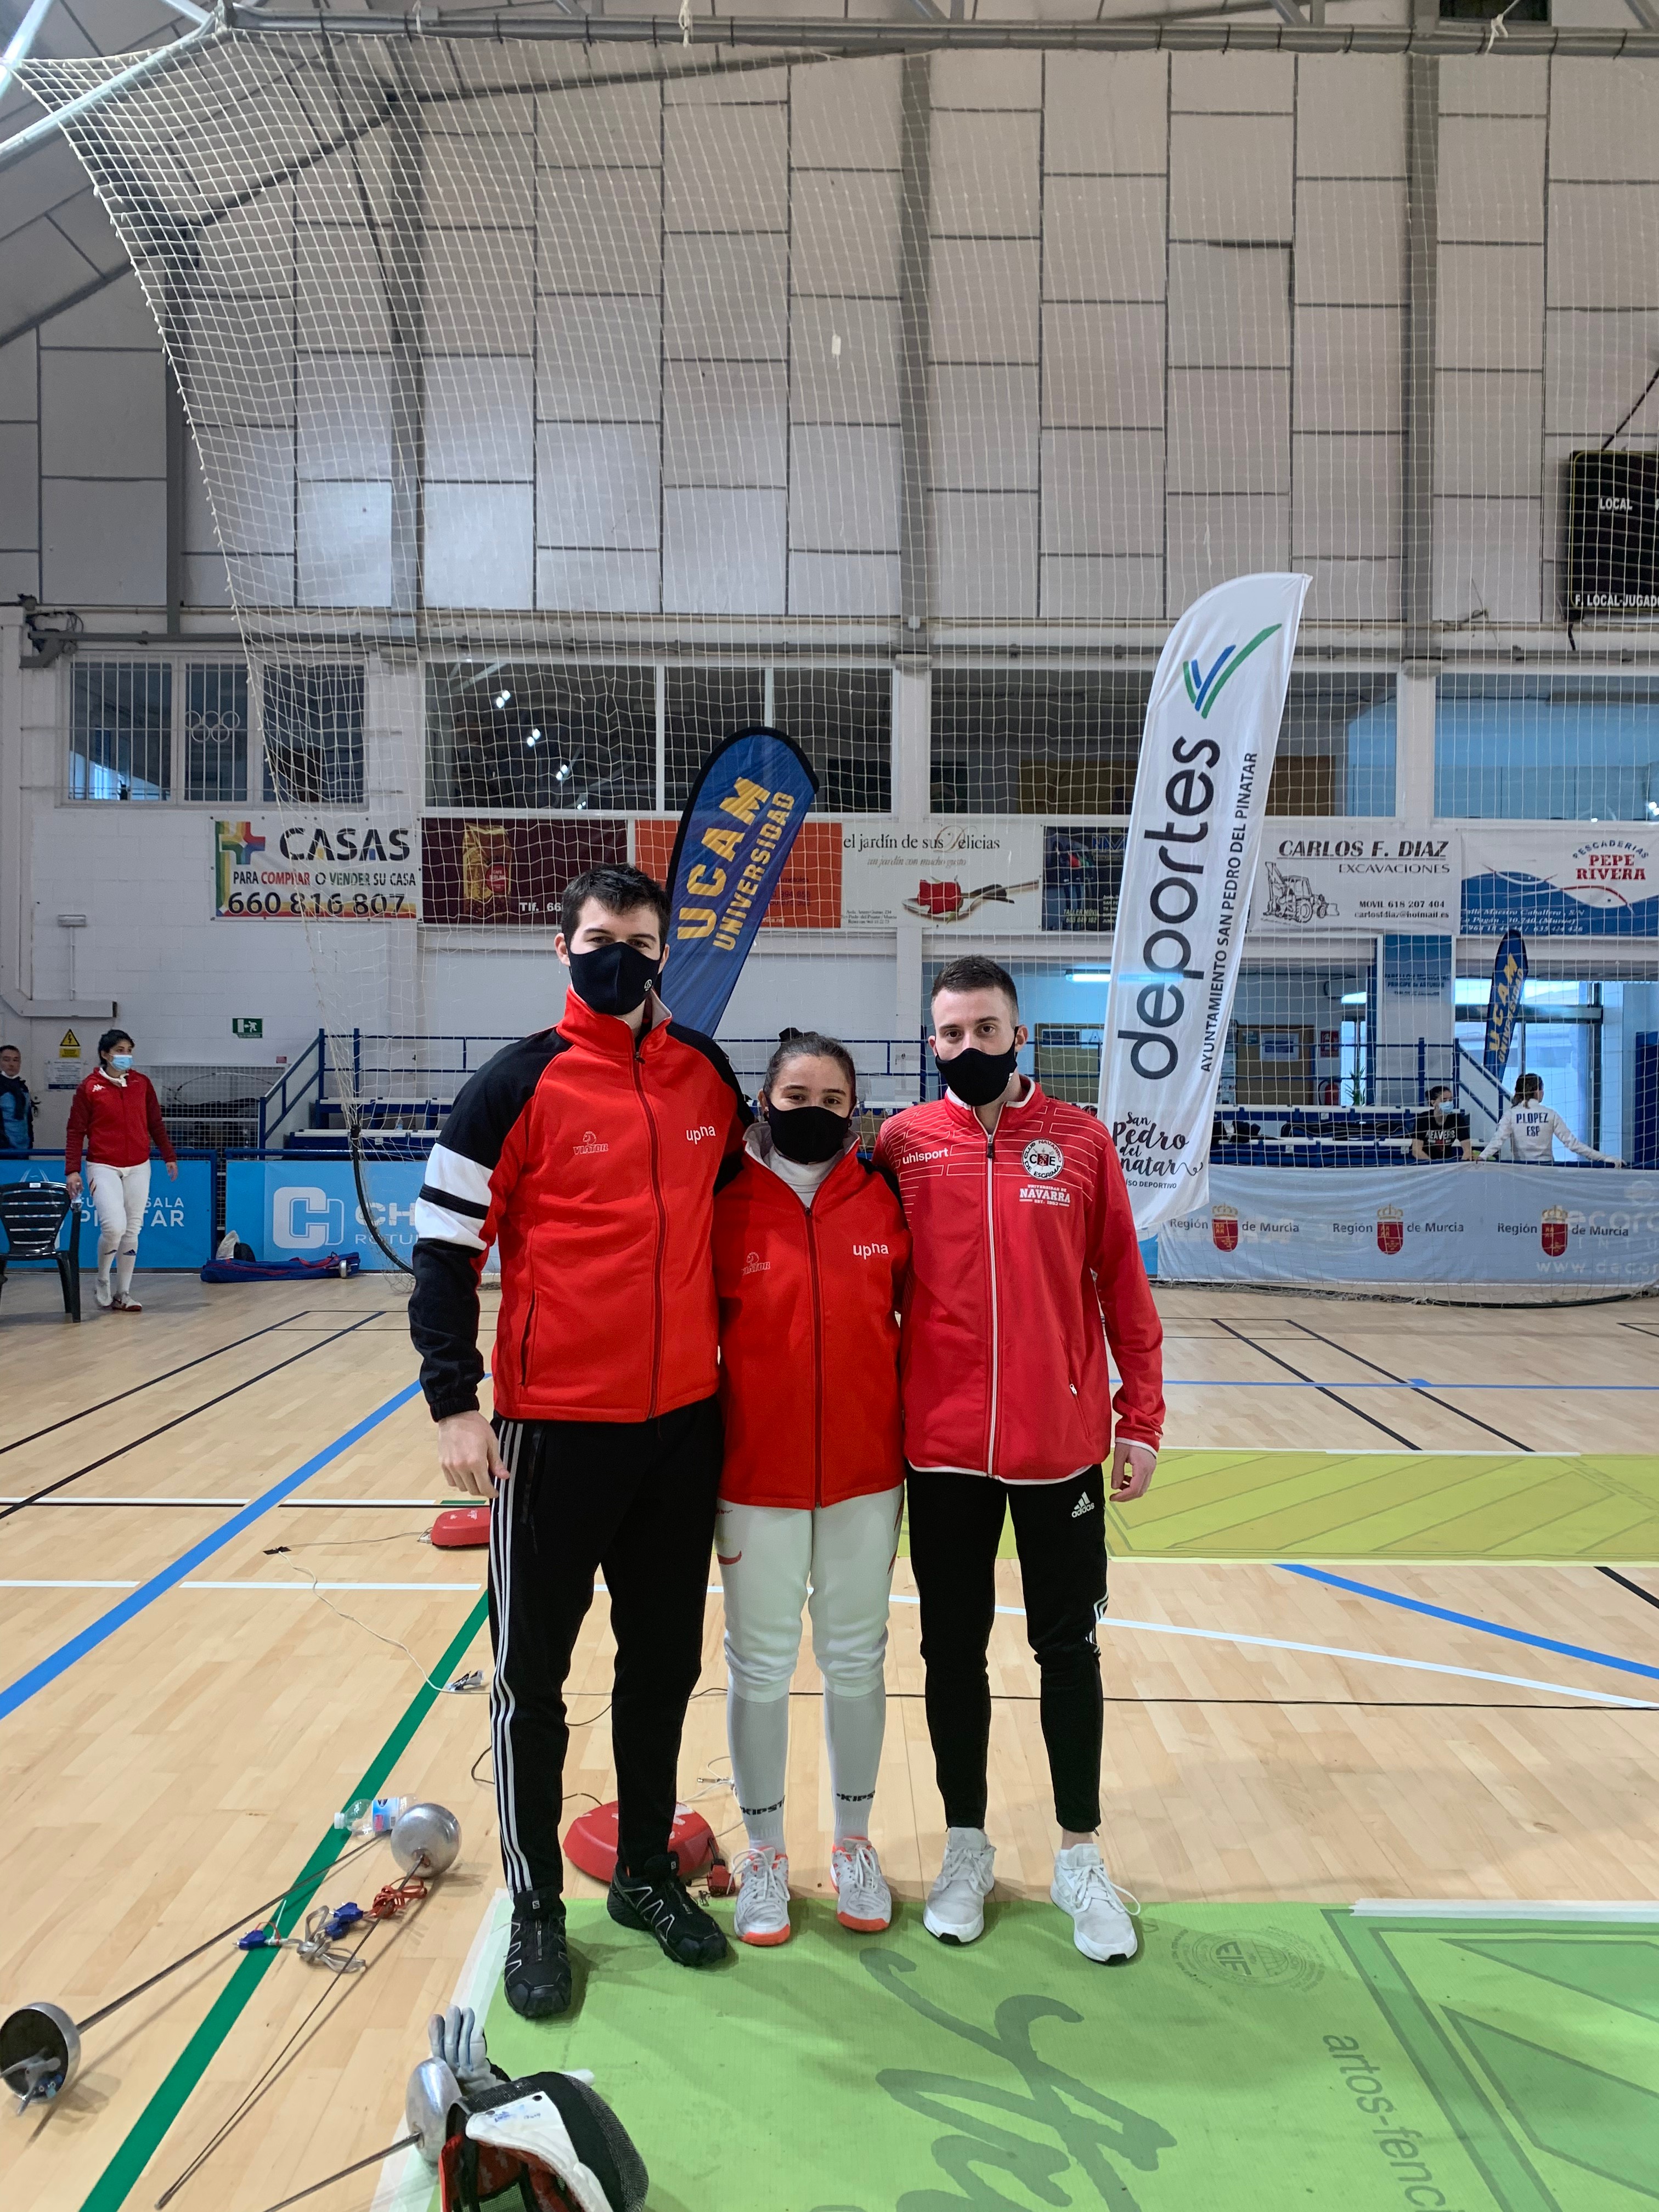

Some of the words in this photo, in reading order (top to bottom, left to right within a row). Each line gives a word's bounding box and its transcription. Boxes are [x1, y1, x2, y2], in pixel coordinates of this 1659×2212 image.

[1599, 497, 1633, 511] LOCAL
[1235, 752, 1257, 818] PINATAR
[280, 827, 410, 861] CASAS
[843, 833, 855, 849] el
[858, 833, 897, 852] jardín
[901, 834, 918, 849] de
[922, 838, 944, 850] sus
[933, 825, 1000, 853] Delicias
[1230, 823, 1246, 853] DEL
[1279, 840, 1363, 857] CARLOS
[1372, 840, 1389, 857] F.
[1398, 840, 1449, 857] DIAZ
[678, 777, 771, 940] UCAM
[1588, 854, 1635, 866] PEPE
[713, 791, 795, 951] UNIVERSIDAD
[1339, 864, 1450, 873] EXCAVACIONES
[1576, 867, 1646, 881] RIVERA
[233, 871, 259, 884] PARA
[261, 872, 310, 885] COMPRAR
[315, 872, 326, 885] O
[329, 872, 370, 885] VENDER
[374, 873, 386, 885] SU
[390, 873, 416, 886] CASA
[1222, 857, 1241, 910] PEDRO
[228, 892, 281, 915] 660
[290, 893, 343, 915] 816
[353, 893, 405, 915] 807
[520, 902, 539, 911] Tlf.
[546, 902, 563, 912] 66
[1118, 736, 1220, 1080] deportes
[1217, 914, 1233, 946] SAN
[1489, 952, 1518, 1051] UCAM
[1201, 950, 1227, 1072] AYUNTAMIENTO
[1126, 1111, 1151, 1126] San
[686, 1125, 716, 1144] upna
[1113, 1121, 1189, 1150] Pedro
[1527, 1126, 1540, 1137] ESP
[902, 1147, 949, 1165] uhlsport
[1024, 1142, 1036, 1159] CLUB
[1039, 1140, 1062, 1163] NAVARRO
[1120, 1143, 1142, 1158] del
[1024, 1160, 1032, 1172] DE
[1034, 1165, 1061, 1178] ESGRIMA
[1121, 1156, 1203, 1176] natar
[1139, 1180, 1177, 1189] DEPORTIVO
[145, 1197, 184, 1208] SALA
[1019, 1188, 1071, 1203] NAVARRA
[81, 1210, 185, 1227] PIAR
[1170, 1218, 1209, 1231] Región
[1242, 1221, 1256, 1231] de
[1261, 1222, 1300, 1232] Murcia
[1334, 1222, 1373, 1235] Región
[1407, 1223, 1420, 1233] de
[1425, 1222, 1464, 1233] Murcia
[1497, 1222, 1538, 1235] Región
[1572, 1224, 1586, 1235] de
[1590, 1225, 1629, 1237] Murcia
[853, 1243, 889, 1260] upna
[1071, 1502, 1094, 1518] adidas
[840, 1790, 875, 1802] KIPS
[741, 1795, 785, 1815] KIPST
[1323, 2034, 1452, 2212] artos-fenc
